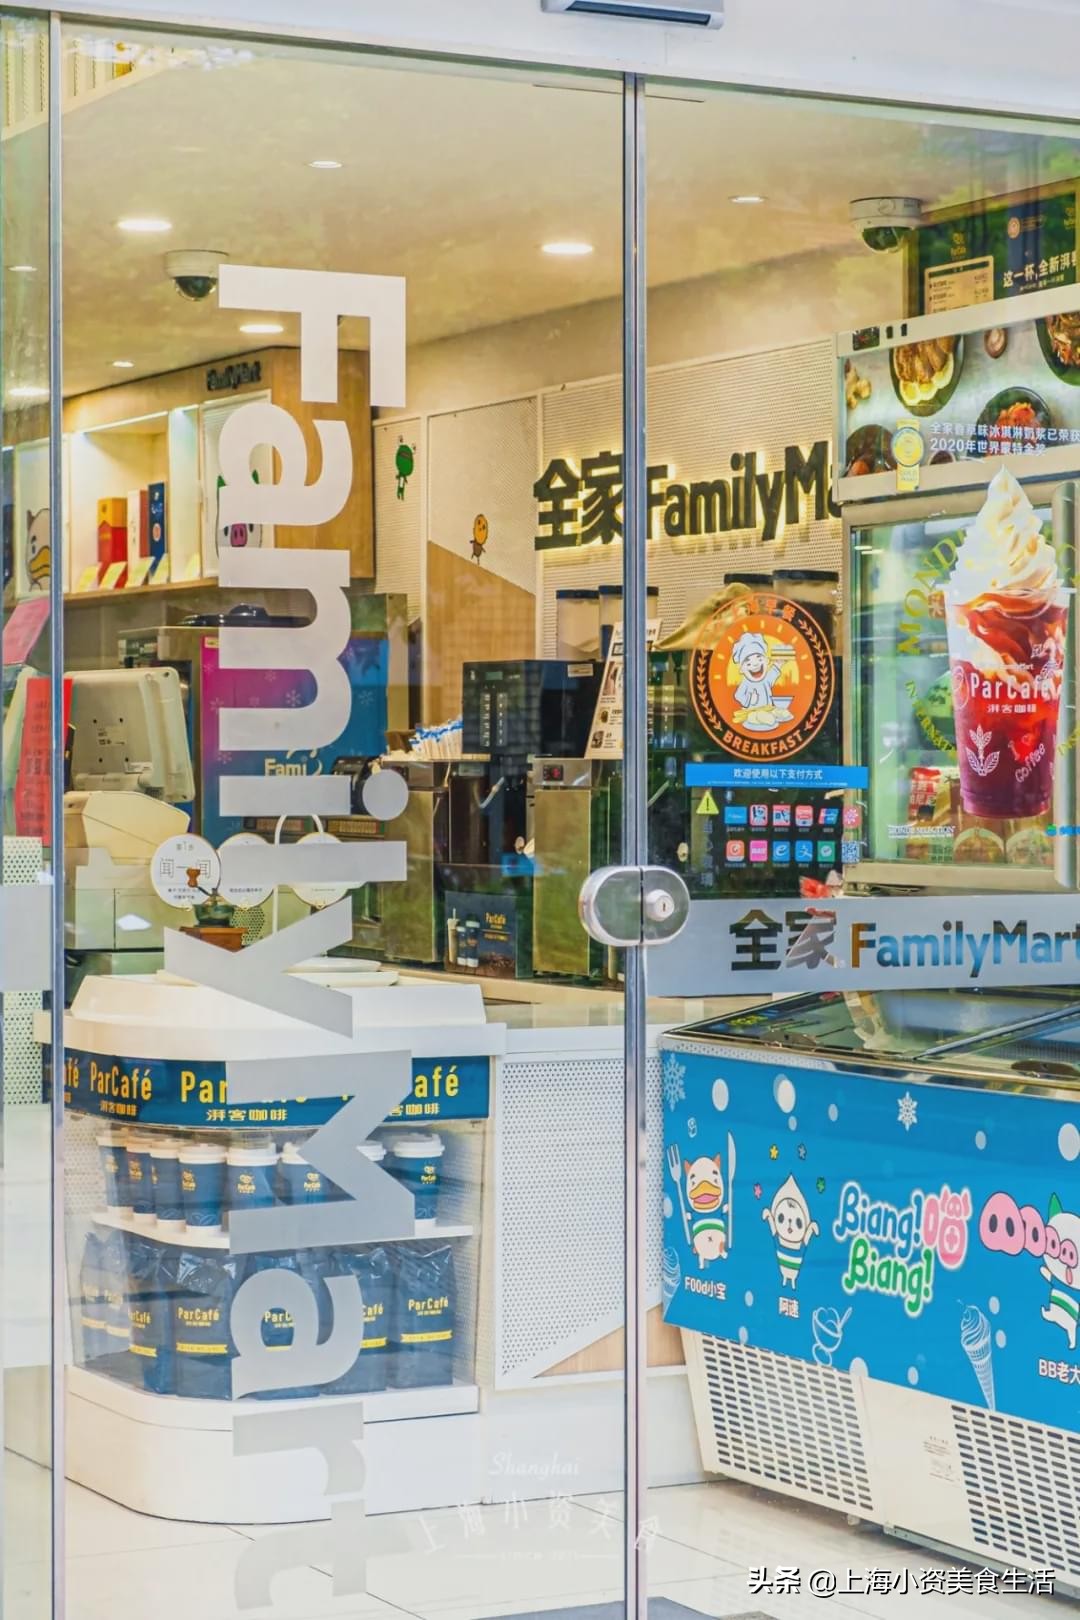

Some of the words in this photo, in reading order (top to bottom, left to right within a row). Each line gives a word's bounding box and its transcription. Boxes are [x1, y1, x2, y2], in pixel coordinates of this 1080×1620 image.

[534, 450, 623, 551] 全家
[898, 530, 968, 656] MOND
[722, 729, 804, 757] BREAKFAST
[733, 767, 823, 780] 欢迎使用以下支付方式
[729, 908, 838, 971] 全家
[90, 1061, 152, 1101] ParCafé
[206, 1108, 288, 1121] 湃客咖啡
[389, 1103, 440, 1116] 客咖啡
[833, 1182, 925, 1260] Biang!
[843, 1238, 933, 1317] Biang!
[178, 1307, 220, 1321] ParCafé
[409, 1296, 449, 1312] ParCafé
[1039, 1358, 1080, 1385] BB老大
